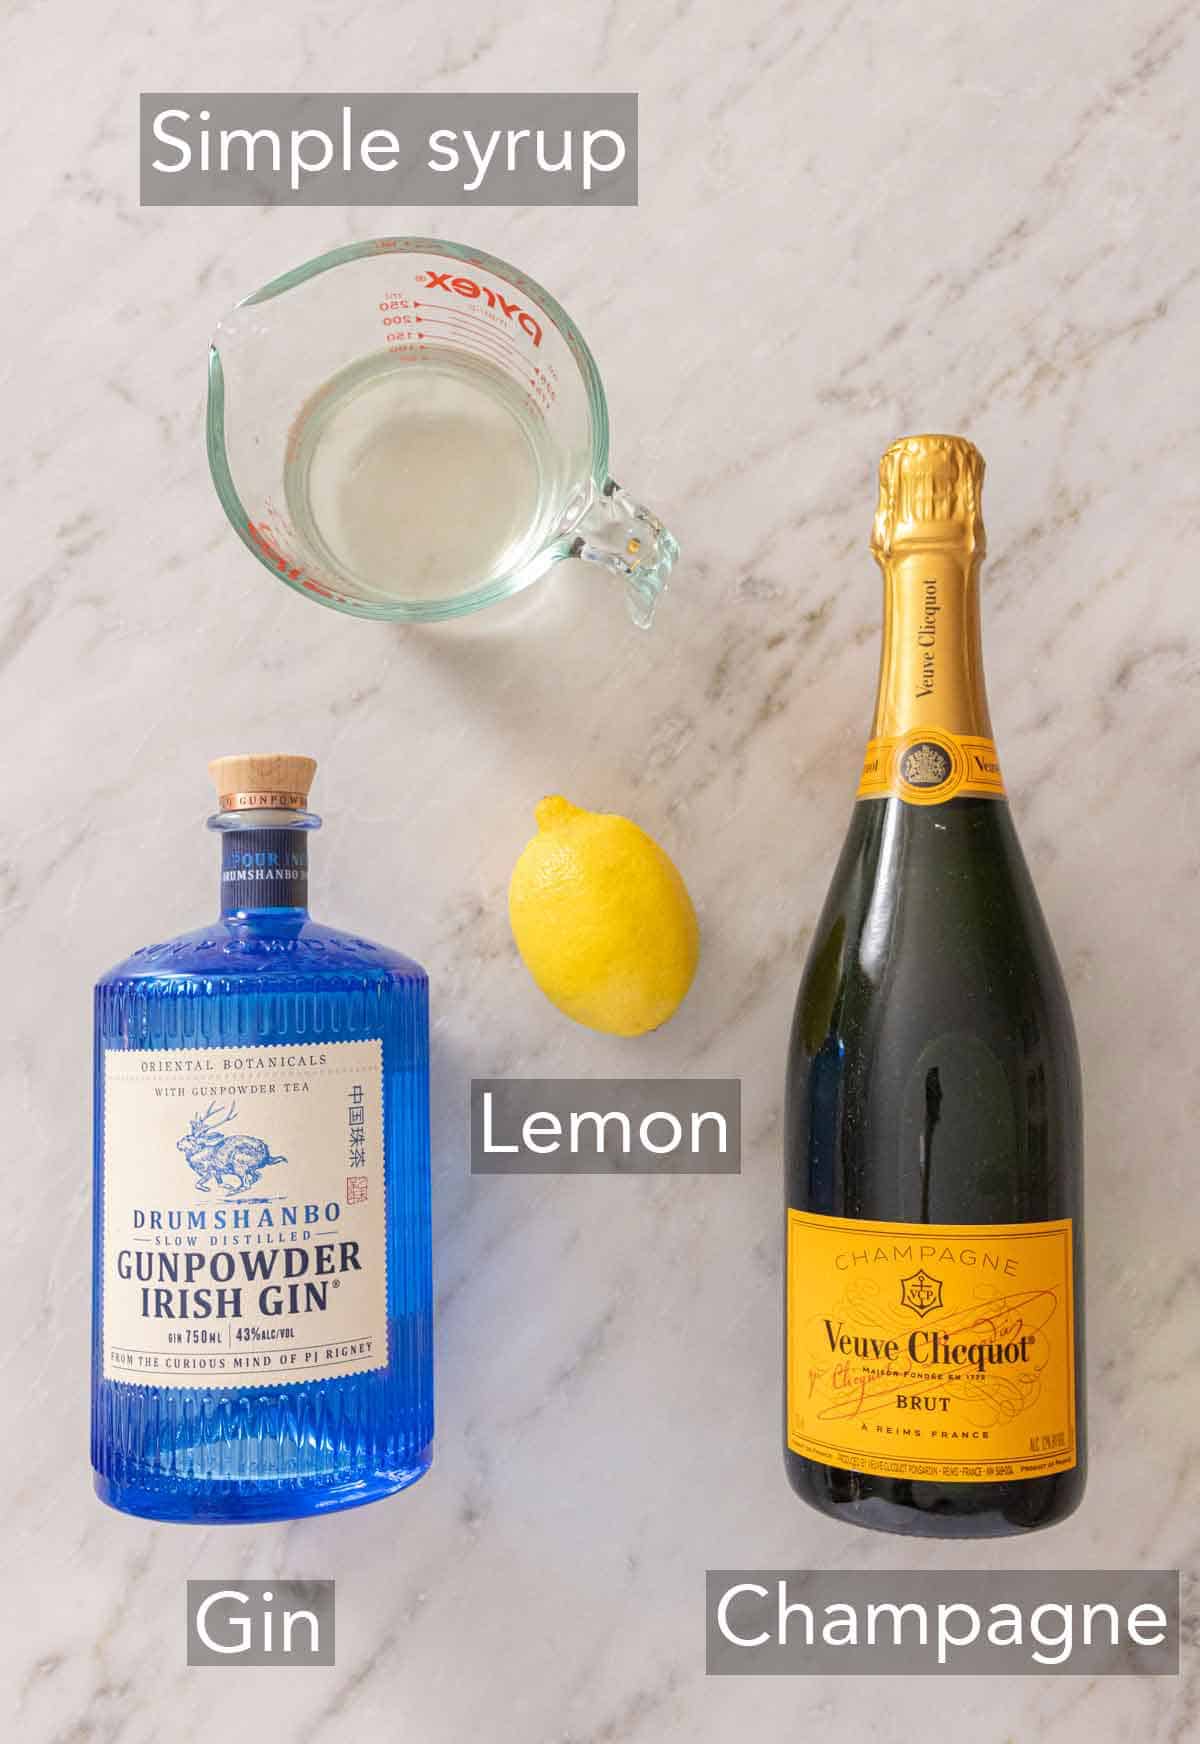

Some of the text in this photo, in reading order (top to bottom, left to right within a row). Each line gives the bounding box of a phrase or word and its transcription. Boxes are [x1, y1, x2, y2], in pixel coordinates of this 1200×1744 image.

[915, 578, 941, 699] Veuve Clicquot
[222, 869, 299, 881] RUMSHANBO
[141, 1054, 328, 1073] ORIENTAL BOTANICALS
[154, 1082, 310, 1097] WITH GUNPOWDER TEA
[133, 1201, 340, 1231] DRUMSHANBO
[155, 1230, 311, 1247] SLOW DISTILLED
[117, 1240, 362, 1283] GUNPOWDER
[834, 1245, 1020, 1278] CHAMPAGNE
[141, 1287, 243, 1319] IRISH
[910, 1289, 934, 1300] VCP
[168, 1332, 183, 1344] GIN
[186, 1329, 223, 1344] 750ML
[824, 1319, 899, 1361] Veuve
[908, 1330, 1031, 1372] Clicquot
[111, 1342, 373, 1369] FROM THE CURIOUS MIND OF PJ RIGNEY
[895, 1394, 951, 1412] BRUT
[876, 1425, 921, 1437] REIMS
[931, 1431, 990, 1439] FRANCE
